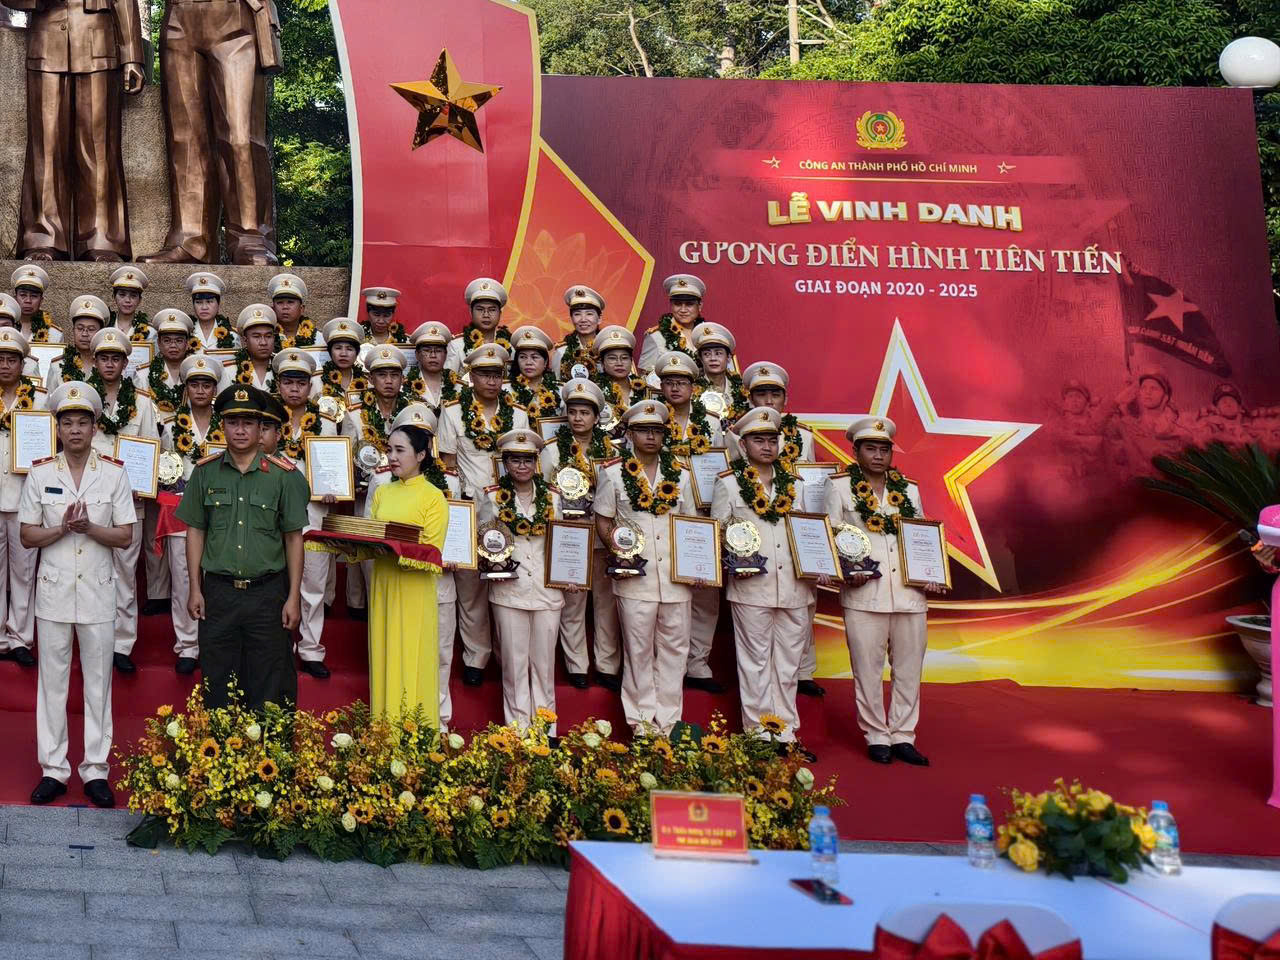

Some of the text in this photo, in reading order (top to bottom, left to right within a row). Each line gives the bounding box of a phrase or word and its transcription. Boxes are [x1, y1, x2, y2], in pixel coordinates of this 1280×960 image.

[799, 159, 978, 173] CÔNG AN THÀNH PHỐ HỒ CHÍ MINH
[767, 191, 1023, 232] LỄ VINH DANH
[679, 236, 1123, 275] GƯƠNG ĐIỂN HÌNH TIÊN TIẾN
[795, 279, 831, 294] GIAI
[835, 280, 882, 298] ĐOẠN
[886, 281, 925, 296] 2020
[939, 282, 978, 297] 2025
